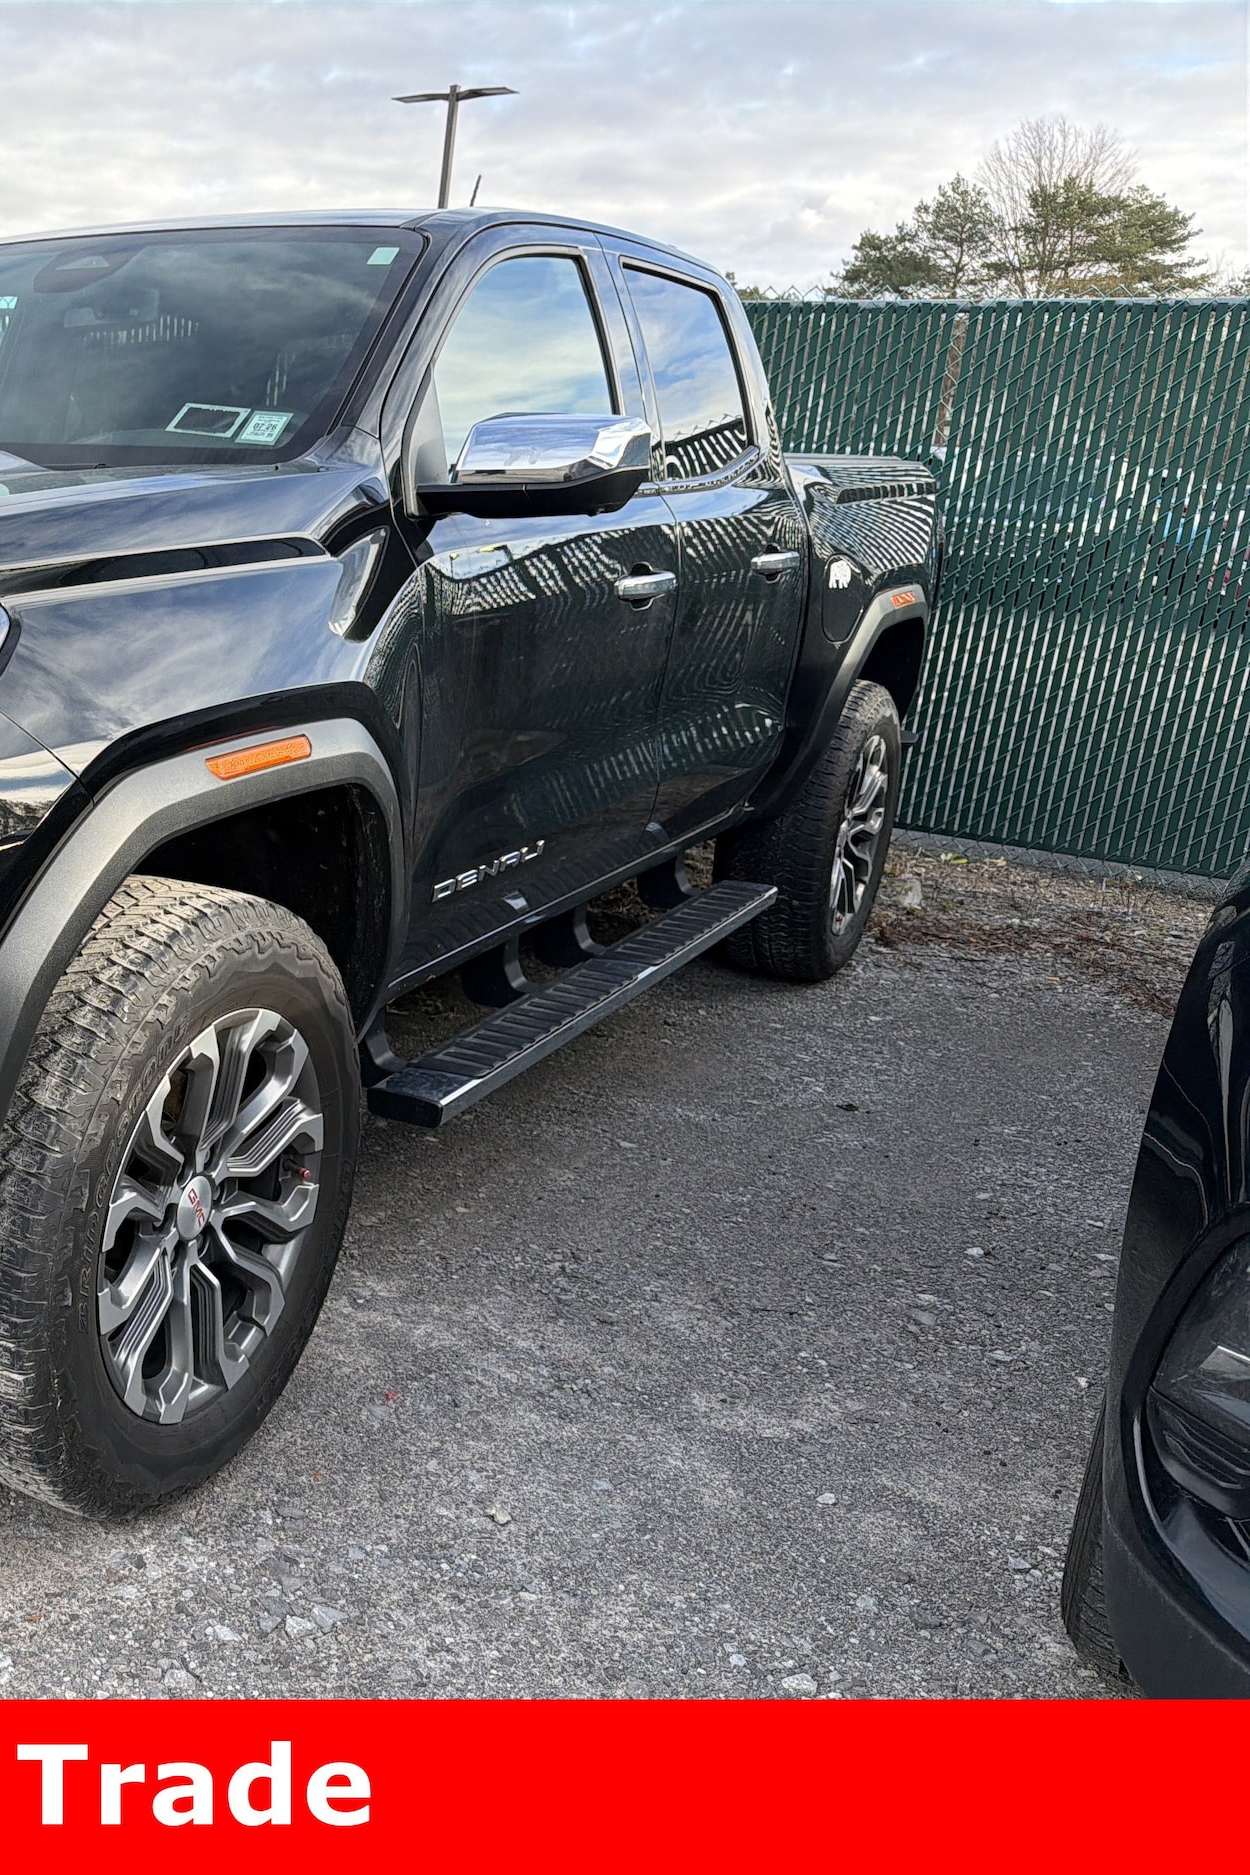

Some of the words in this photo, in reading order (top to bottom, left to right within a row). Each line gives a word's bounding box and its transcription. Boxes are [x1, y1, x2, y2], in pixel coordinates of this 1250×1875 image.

[253, 422, 265, 431] 07
[266, 423, 278, 431] 26
[432, 839, 545, 903] DENALI
[187, 1187, 205, 1228] GMC
